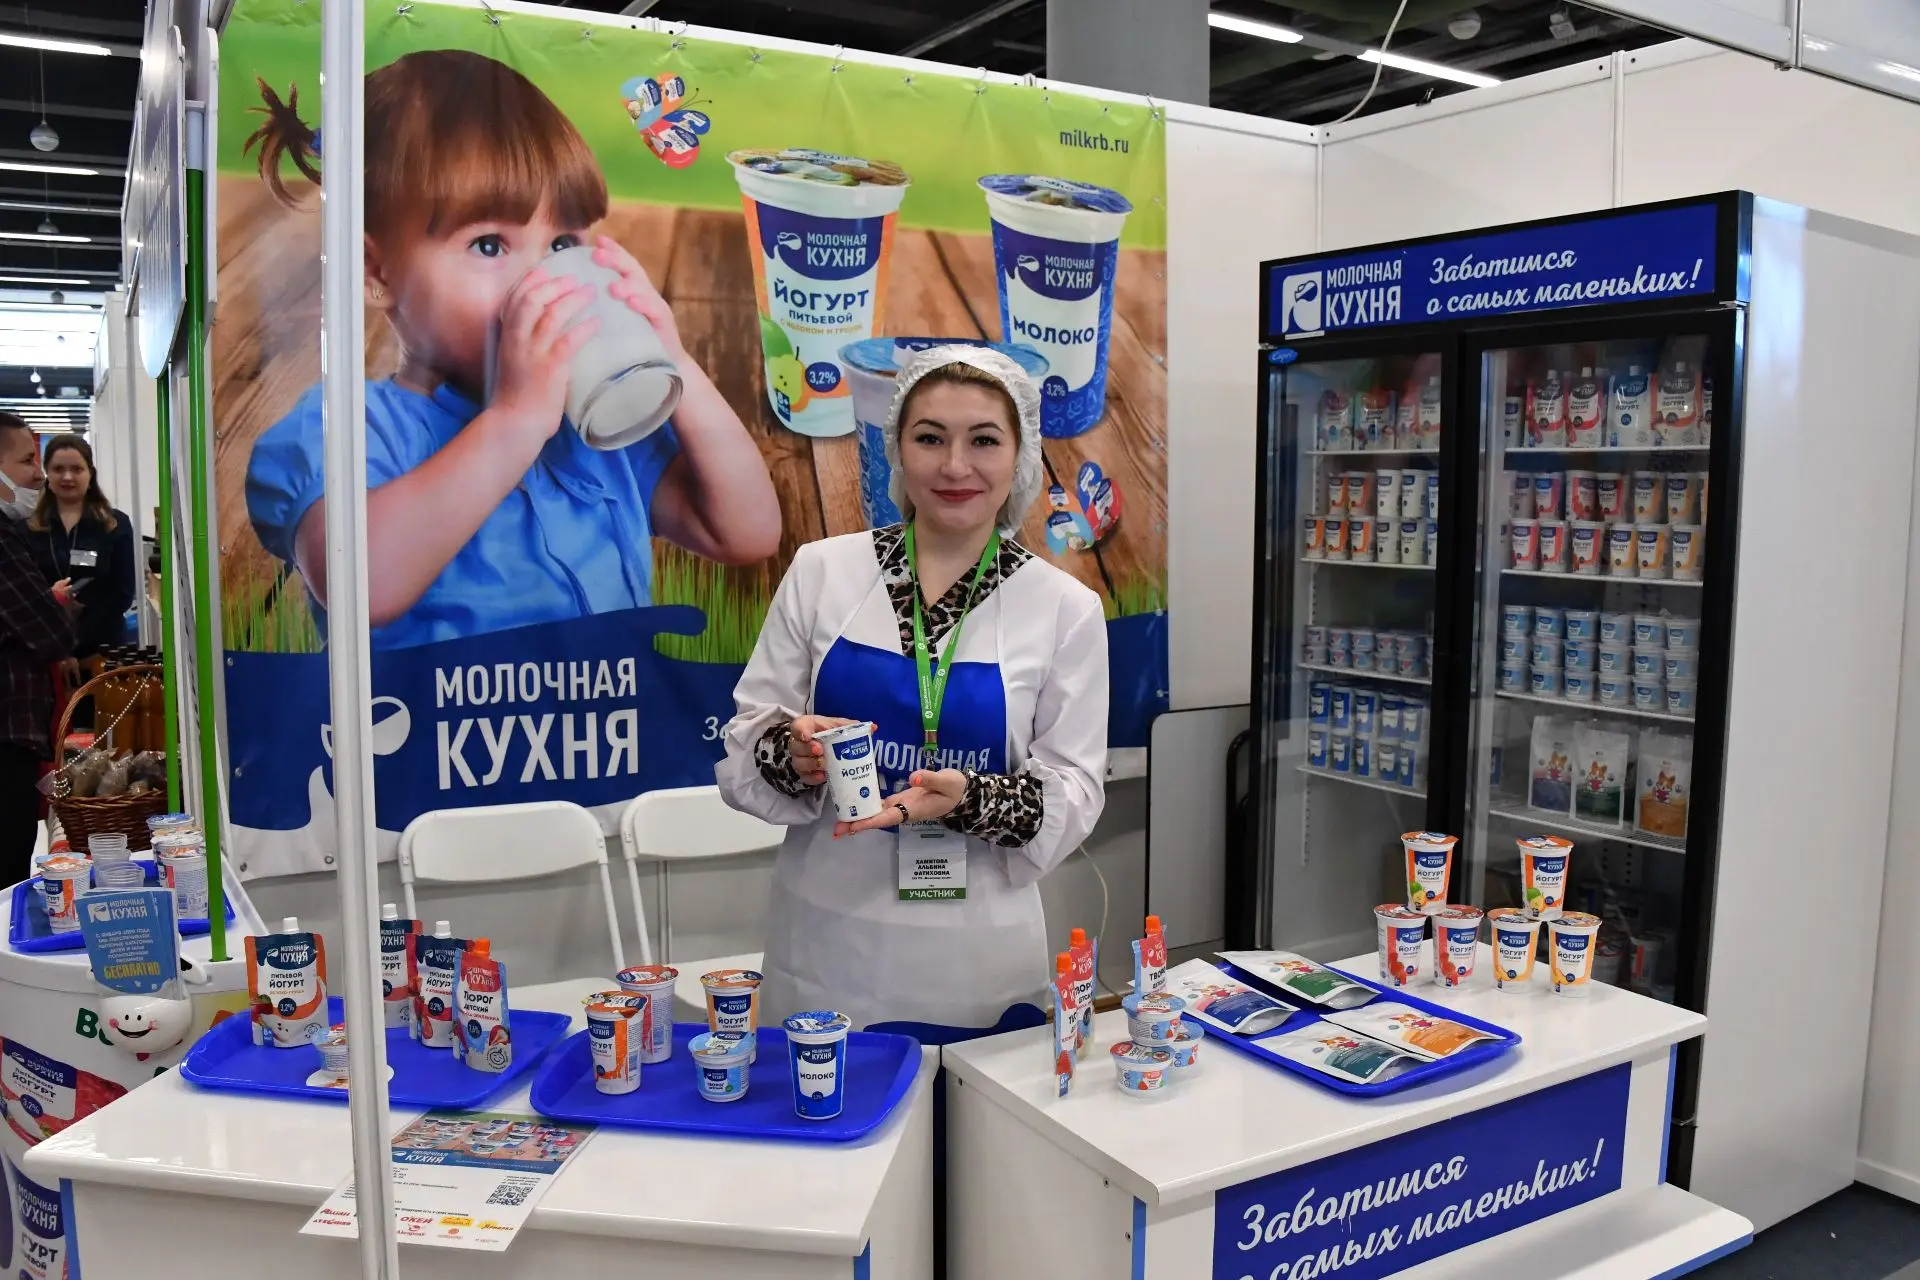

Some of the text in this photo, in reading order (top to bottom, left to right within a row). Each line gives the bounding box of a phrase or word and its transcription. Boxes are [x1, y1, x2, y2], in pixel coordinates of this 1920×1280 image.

[1060, 129, 1129, 153] milkrb.ru
[807, 232, 868, 246] МОЛОЧНАЯ
[807, 247, 867, 267] КУХНЯ
[1045, 255, 1095, 269] МОЛОЧНАЯ
[1327, 259, 1402, 288] МОЛОЧНАЯ
[1429, 250, 1577, 285] Заботимся
[1045, 268, 1093, 289] КУХНЯ
[1426, 258, 1703, 315] о самых маленьких!
[774, 278, 869, 311] ЙОГУРТ
[1325, 285, 1401, 327] КУХНЯ
[788, 309, 853, 324] ПИТЬЕВОЙ
[1013, 315, 1095, 344] МОЛОКО
[809, 371, 837, 385] 3,2%
[1046, 383, 1066, 398] 3,2%
[435, 657, 637, 708] МОЛОЧНАЯ
[436, 709, 639, 790] КУХНЯ
[875, 740, 990, 773] МОЛОЧНАЯ
[841, 763, 873, 778] ЙОГУРТ
[1417, 869, 1444, 877] ЙОГУРТ
[1536, 874, 1563, 882] ЙОГУРТ
[909, 889, 956, 898] УЧАСТНИК
[110, 898, 145, 907] МОЛОЧНАЯ
[112, 906, 147, 919] КУХНЯ
[280, 951, 308, 963] КУХНЯ
[1500, 947, 1527, 956] ЙОГУРТ
[1558, 951, 1585, 959] ЙОГУРТ
[269, 979, 304, 988] ЙОГУРТ
[427, 978, 454, 988] ЙОГУР
[729, 1003, 746, 1011] КУХНЯ
[718, 1016, 748, 1024] ЙОГУРТ
[812, 1052, 831, 1060] КУХНЯ
[800, 1072, 834, 1080] МОЛОКО
[13, 1072, 56, 1097] ЙОГУРТ
[405, 1154, 445, 1164] КУХНЯ
[18, 1184, 58, 1213] МОЛОЧНАЯ
[1237, 1155, 1468, 1251] Заботимся
[19, 1199, 57, 1231] КУХНЯ
[1269, 1138, 1605, 1280] самых маленьких!
[22, 1232, 58, 1263] ГУРТ
